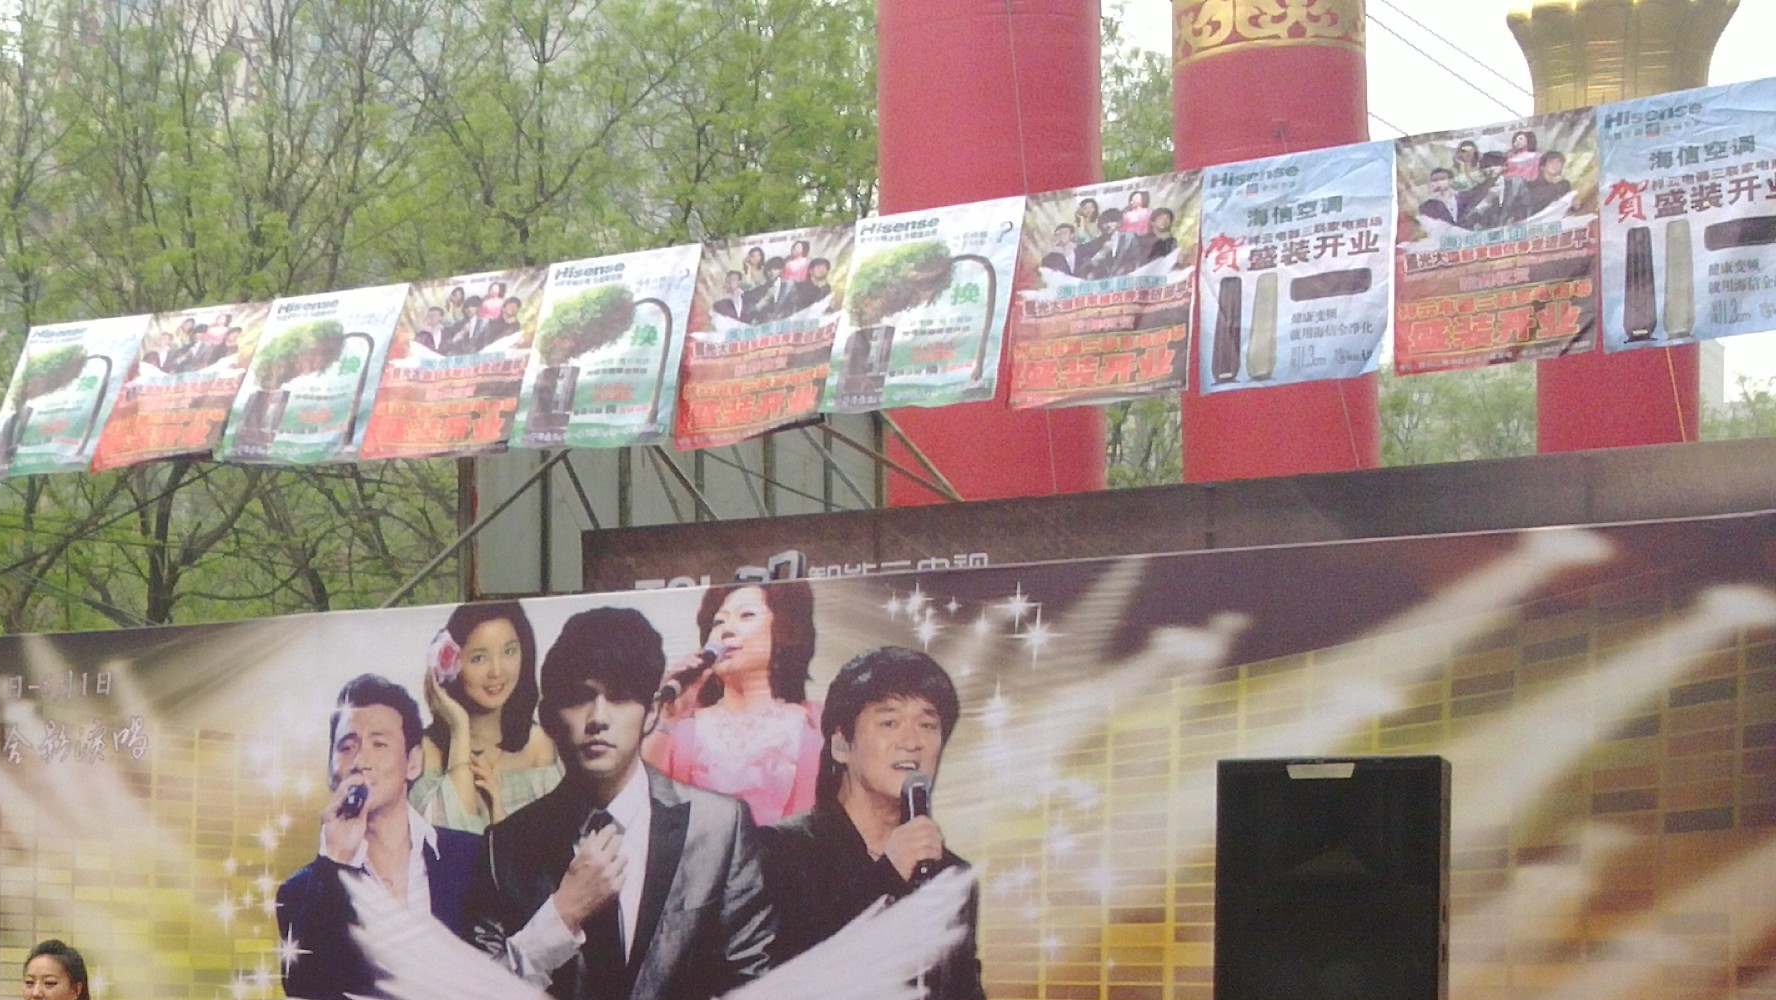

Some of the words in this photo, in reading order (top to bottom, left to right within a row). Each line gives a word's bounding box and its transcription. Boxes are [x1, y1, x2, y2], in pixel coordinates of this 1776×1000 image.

[1604, 102, 1703, 129] Hisense
[1649, 135, 1756, 171] 海信空调
[1210, 165, 1300, 189] Hisense
[1246, 195, 1343, 228] 海信空调
[1246, 230, 1380, 272] 盛装开业
